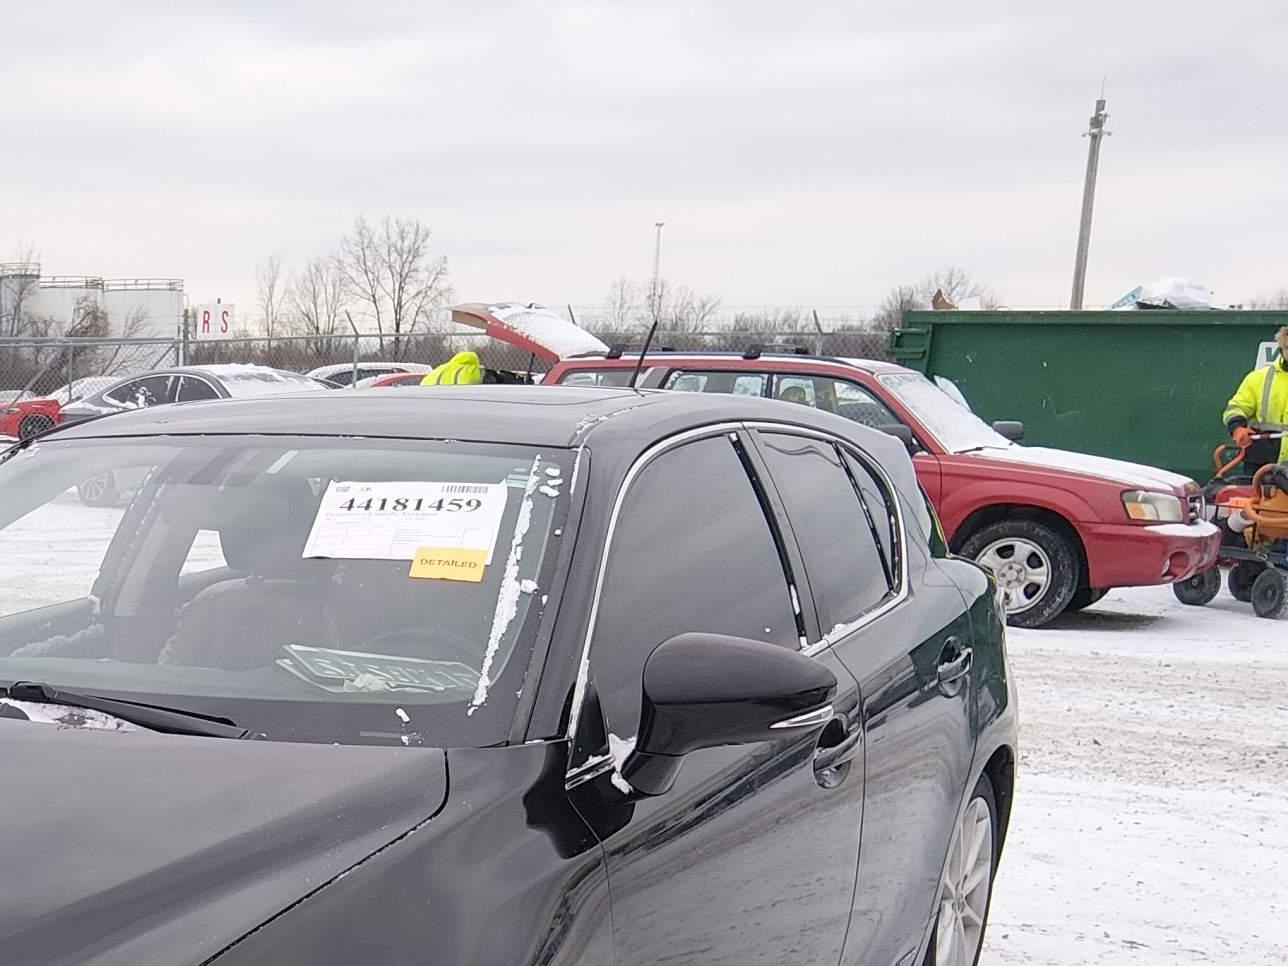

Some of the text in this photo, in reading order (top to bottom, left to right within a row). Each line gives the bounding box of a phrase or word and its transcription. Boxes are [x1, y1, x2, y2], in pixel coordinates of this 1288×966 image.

[201, 310, 229, 334] R S
[339, 497, 482, 512] 44181459
[420, 558, 478, 569] DETAILED
